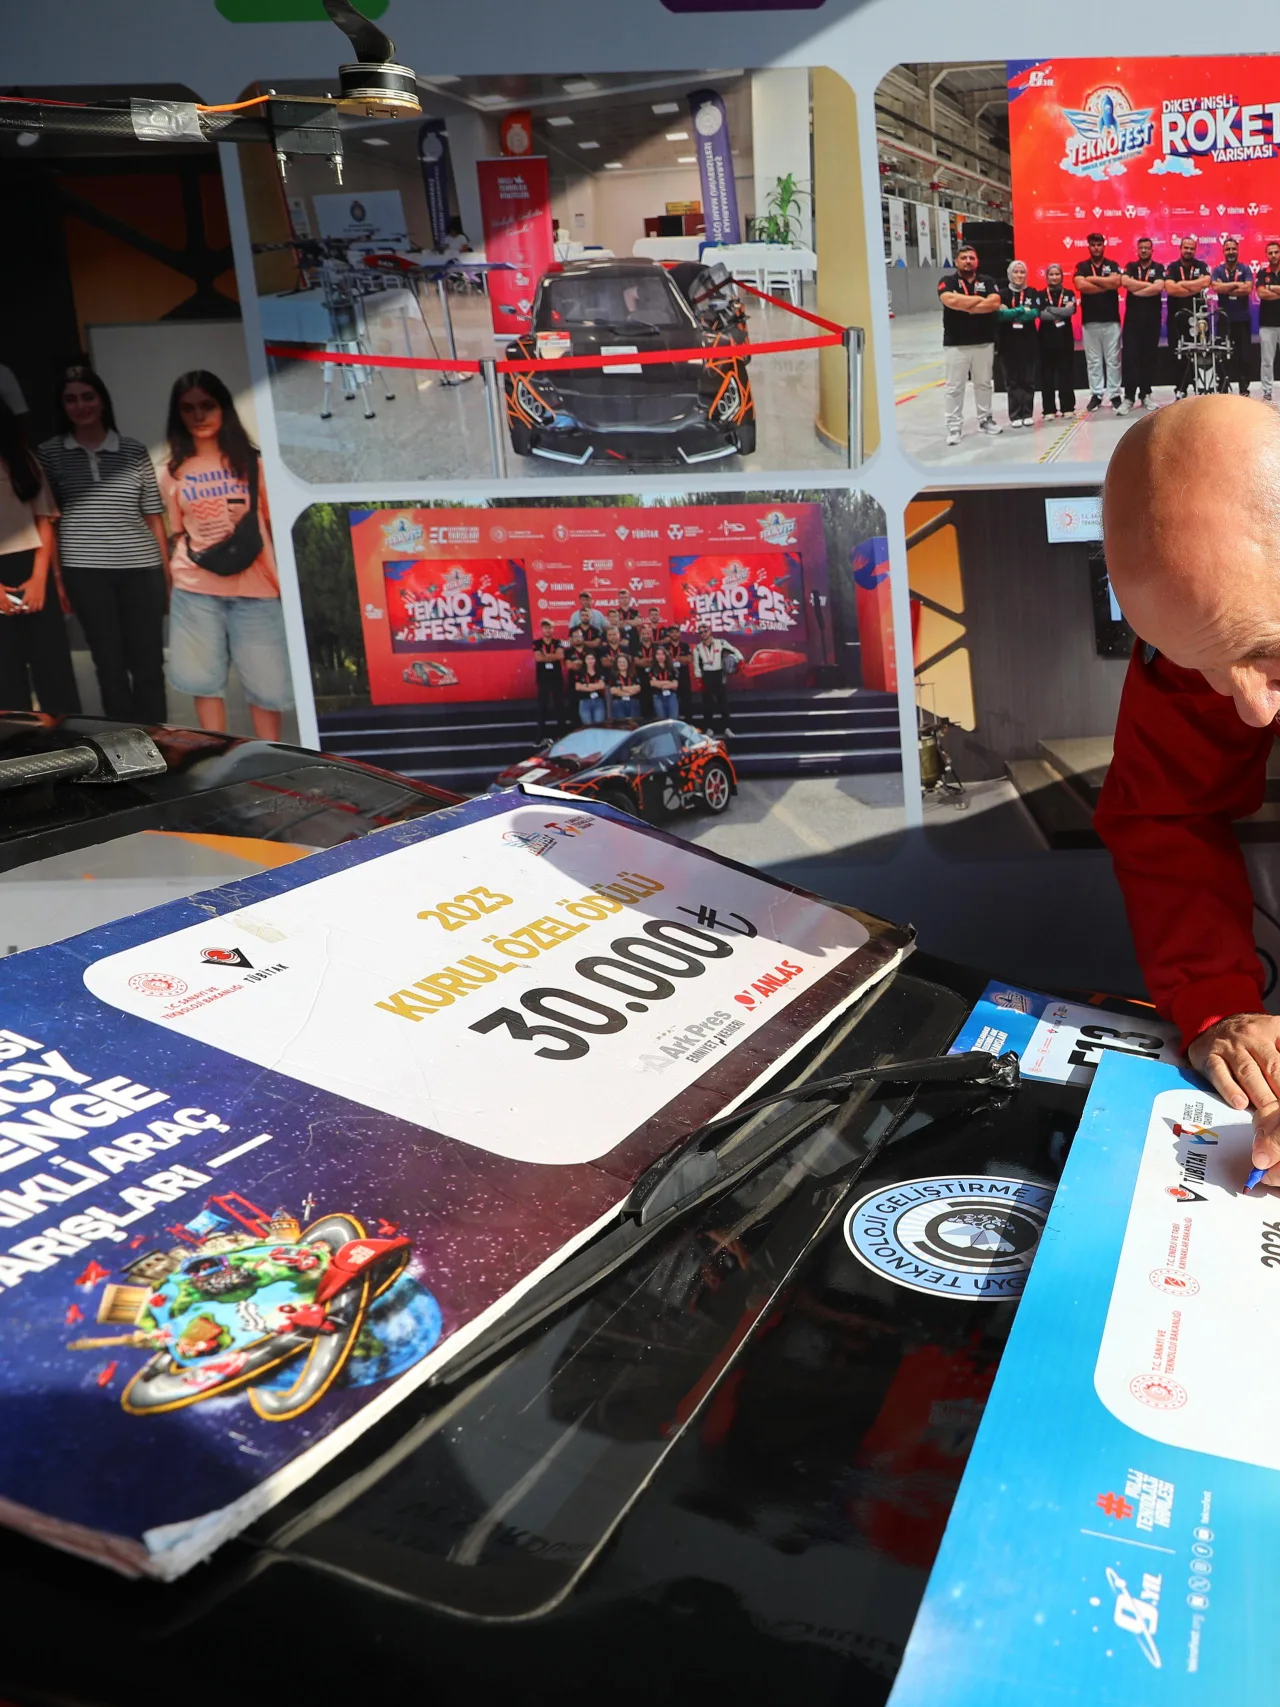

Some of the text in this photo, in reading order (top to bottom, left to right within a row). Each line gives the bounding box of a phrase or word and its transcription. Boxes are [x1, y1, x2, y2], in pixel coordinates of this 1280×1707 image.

[1070, 122, 1153, 166] TEKNOFEST
[184, 467, 238, 486] Sant
[406, 592, 473, 620] TEKNO
[686, 585, 749, 611] TEKNO
[418, 616, 472, 642] FEST
[416, 886, 514, 931] 2023
[374, 871, 665, 1022] KURUL ÖZEL ÖDÜLÜ
[208, 986, 220, 994] VE
[243, 963, 289, 984] TÜBİTAK
[467, 905, 758, 1061] 30.000₺
[750, 959, 804, 998] ANLAS
[659, 1010, 732, 1060] ArkPres
[89, 1108, 230, 1174] ARAÇ
[1180, 1150, 1208, 1185] TÜBİTAK
[862, 1180, 1030, 1289] TEKNOLOJİ GELİŞTİRME
[1178, 1241, 1189, 1270] KAYNAKLAR
[1153, 1338, 1164, 1361] SANAYİ
[1157, 1329, 1166, 1338] VE
[1164, 1310, 1181, 1375] TEKNOLOJİ BAKANLIĞI
